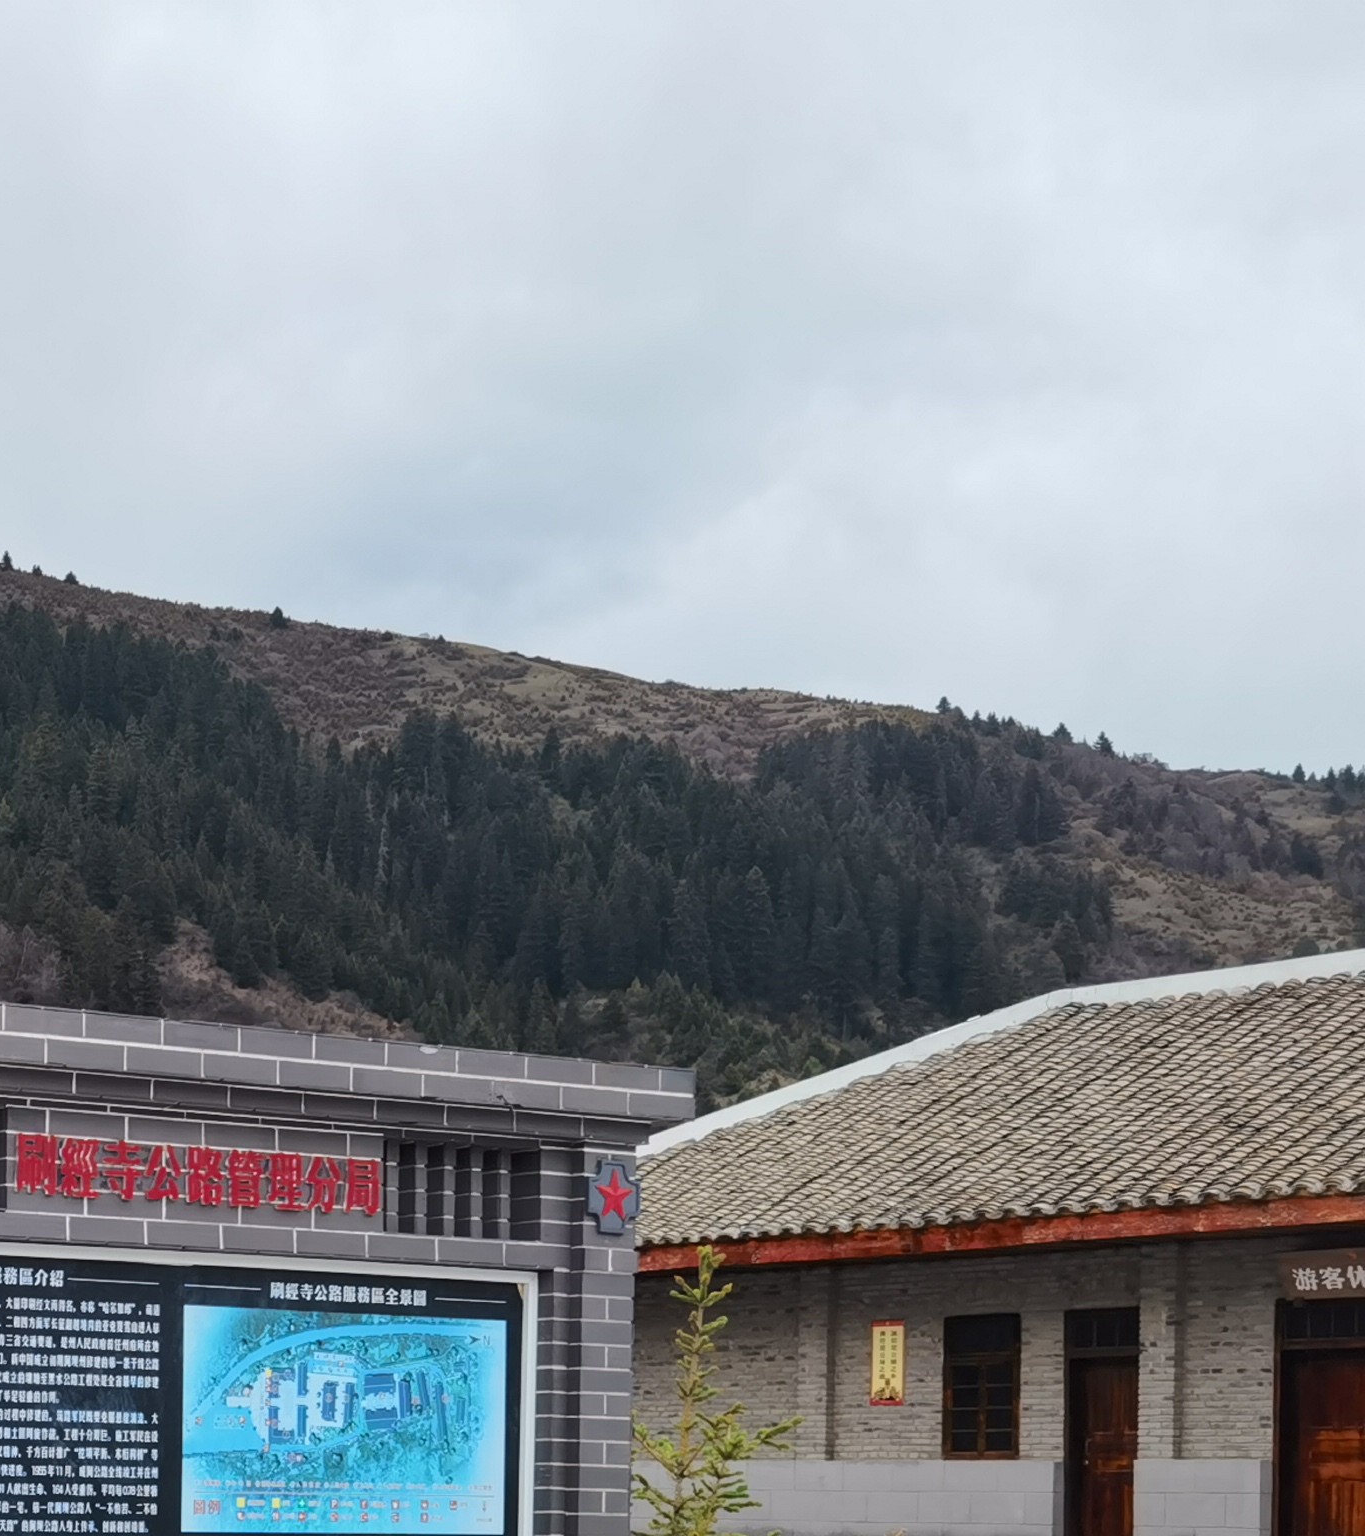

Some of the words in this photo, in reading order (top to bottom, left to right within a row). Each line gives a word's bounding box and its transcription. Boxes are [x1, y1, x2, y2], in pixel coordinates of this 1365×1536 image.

[15, 1132, 382, 1216] 刷經寺公路管理分局
